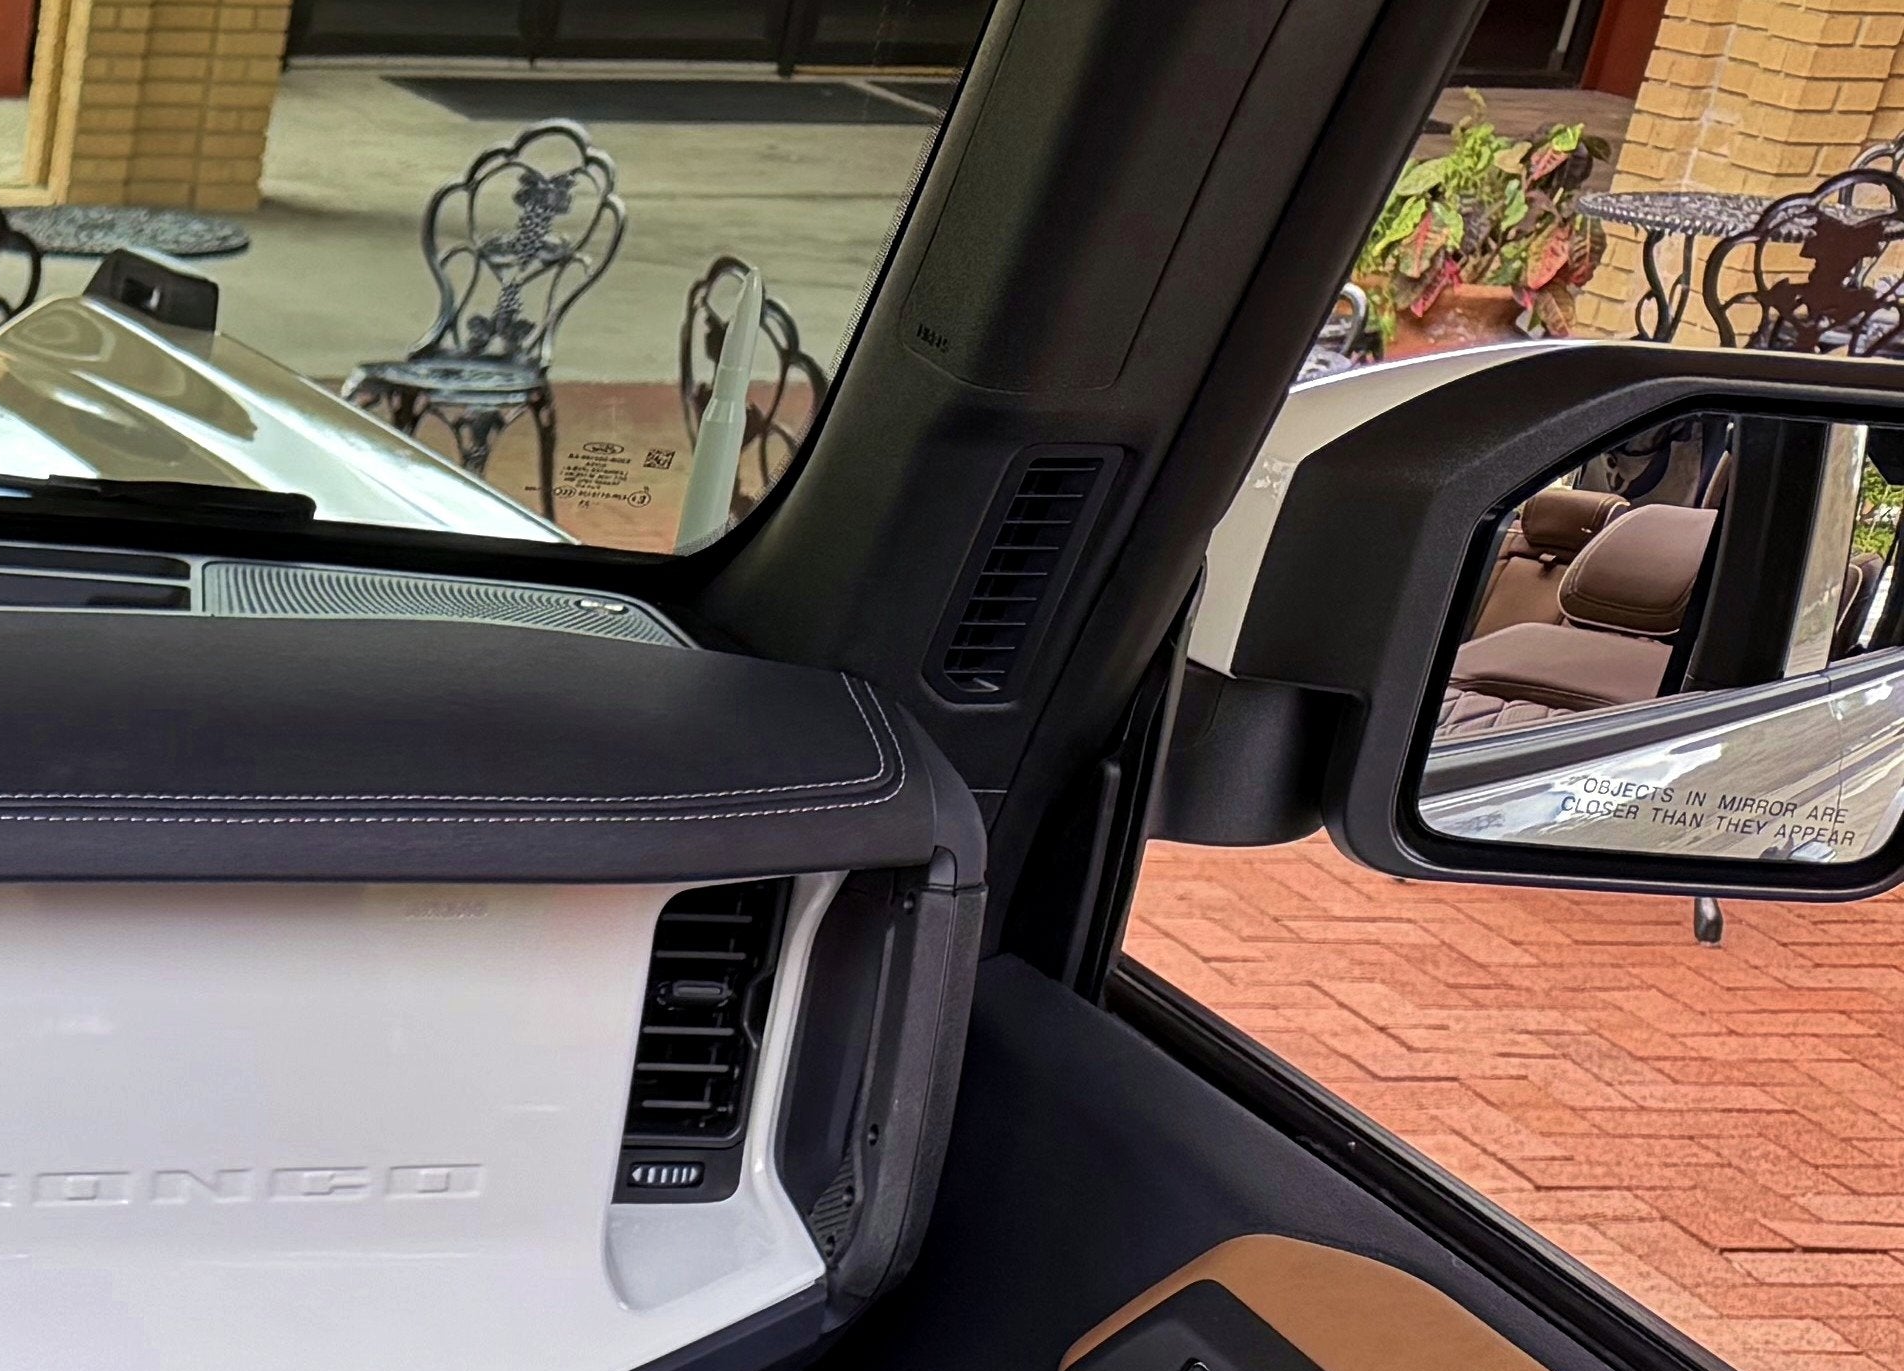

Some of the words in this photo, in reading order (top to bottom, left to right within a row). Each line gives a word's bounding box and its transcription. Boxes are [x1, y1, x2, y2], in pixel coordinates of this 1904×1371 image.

[1561, 796, 1639, 820] CLOSER
[1651, 807, 1704, 828] THAN
[1716, 816, 1768, 835] THEY
[1774, 824, 1857, 846] APPEAR
[1583, 778, 1675, 804] OBJECTS
[1685, 790, 1707, 807] IN
[1718, 795, 1798, 818] MIRROR
[1807, 805, 1849, 824] ARE
